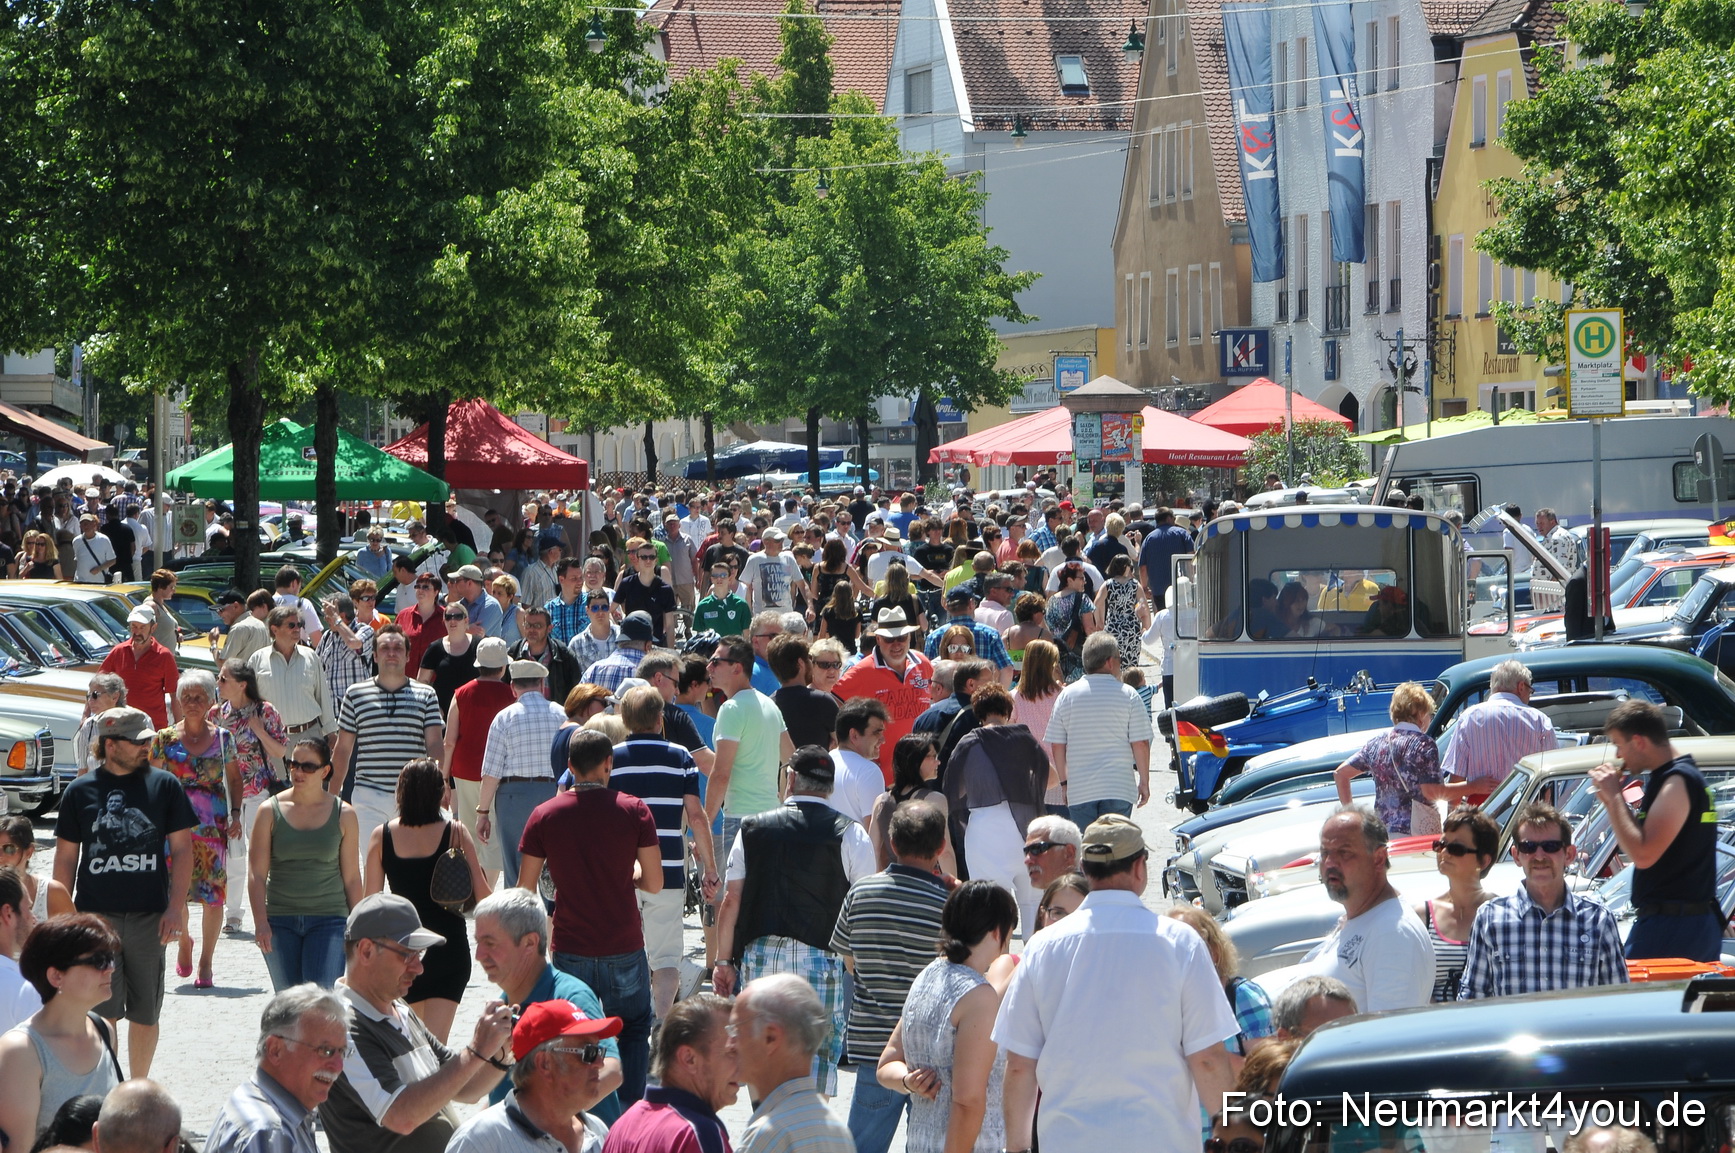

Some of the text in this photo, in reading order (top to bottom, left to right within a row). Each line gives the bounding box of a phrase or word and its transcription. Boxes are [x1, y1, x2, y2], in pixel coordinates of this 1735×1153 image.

[1584, 326, 1605, 349] H
[1482, 351, 1521, 376] Restaurant
[1577, 362, 1613, 370] Marktplatz
[1168, 452, 1188, 460] Hotel
[1188, 453, 1226, 461] Restaurant
[88, 853, 157, 875] CASH
